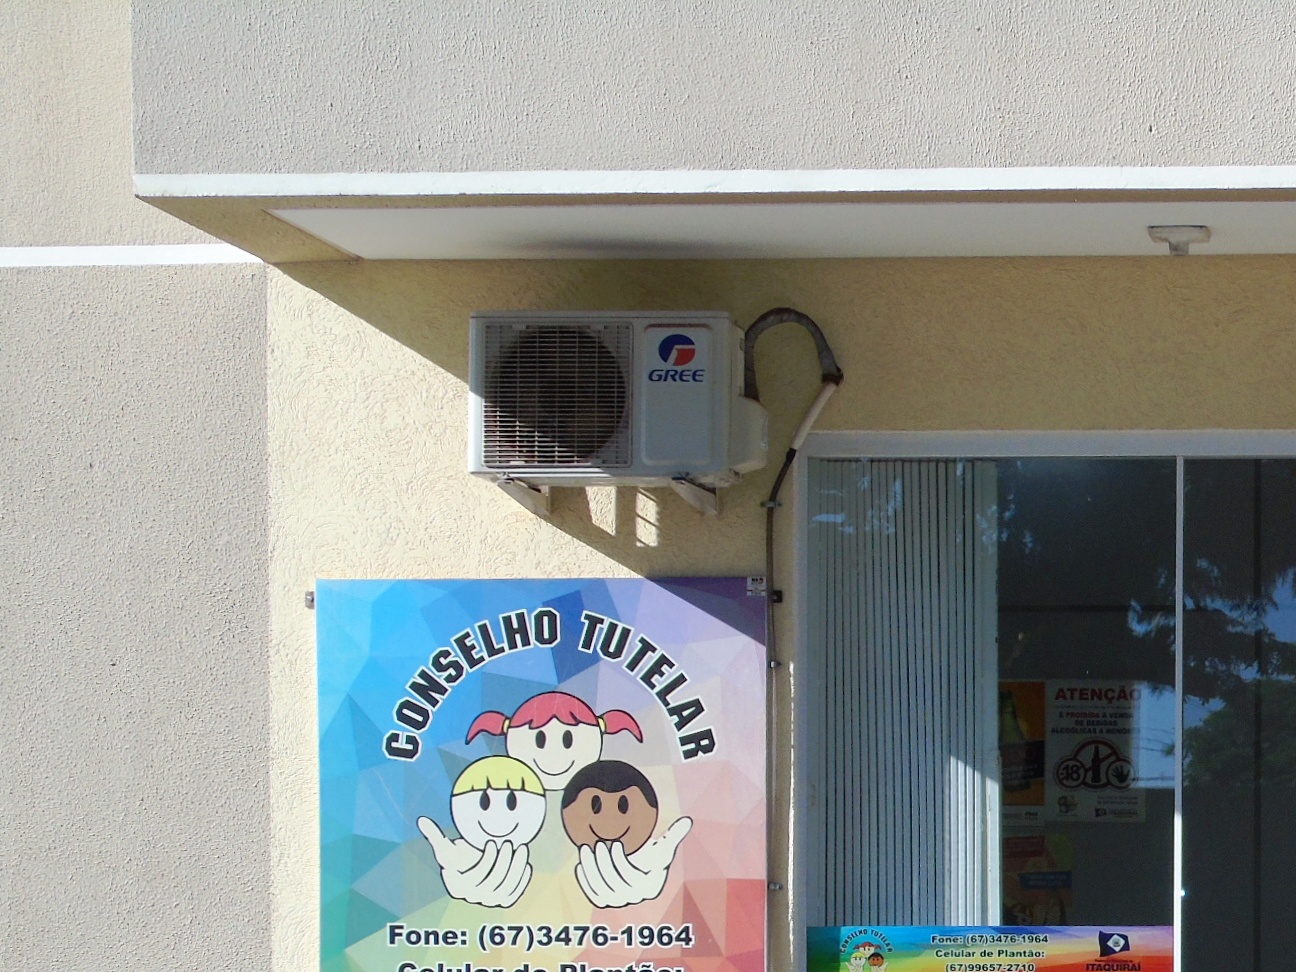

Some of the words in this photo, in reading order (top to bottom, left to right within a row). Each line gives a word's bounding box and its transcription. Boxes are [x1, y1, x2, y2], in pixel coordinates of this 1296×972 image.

[648, 369, 705, 382] GREE
[385, 608, 559, 760] CONSELHO
[580, 612, 715, 759] TUTELAR
[1055, 685, 1142, 704] ATENÇÃO
[388, 925, 467, 947] Fone:
[478, 924, 692, 951] (67)3476-1964
[931, 935, 962, 944] Fone:
[966, 935, 1048, 946] (67)3476-1964
[935, 949, 976, 958] Celular
[980, 949, 994, 958] de
[997, 949, 1045, 958] Plantão:
[1086, 961, 1141, 972] ITAQUIRAÍ
